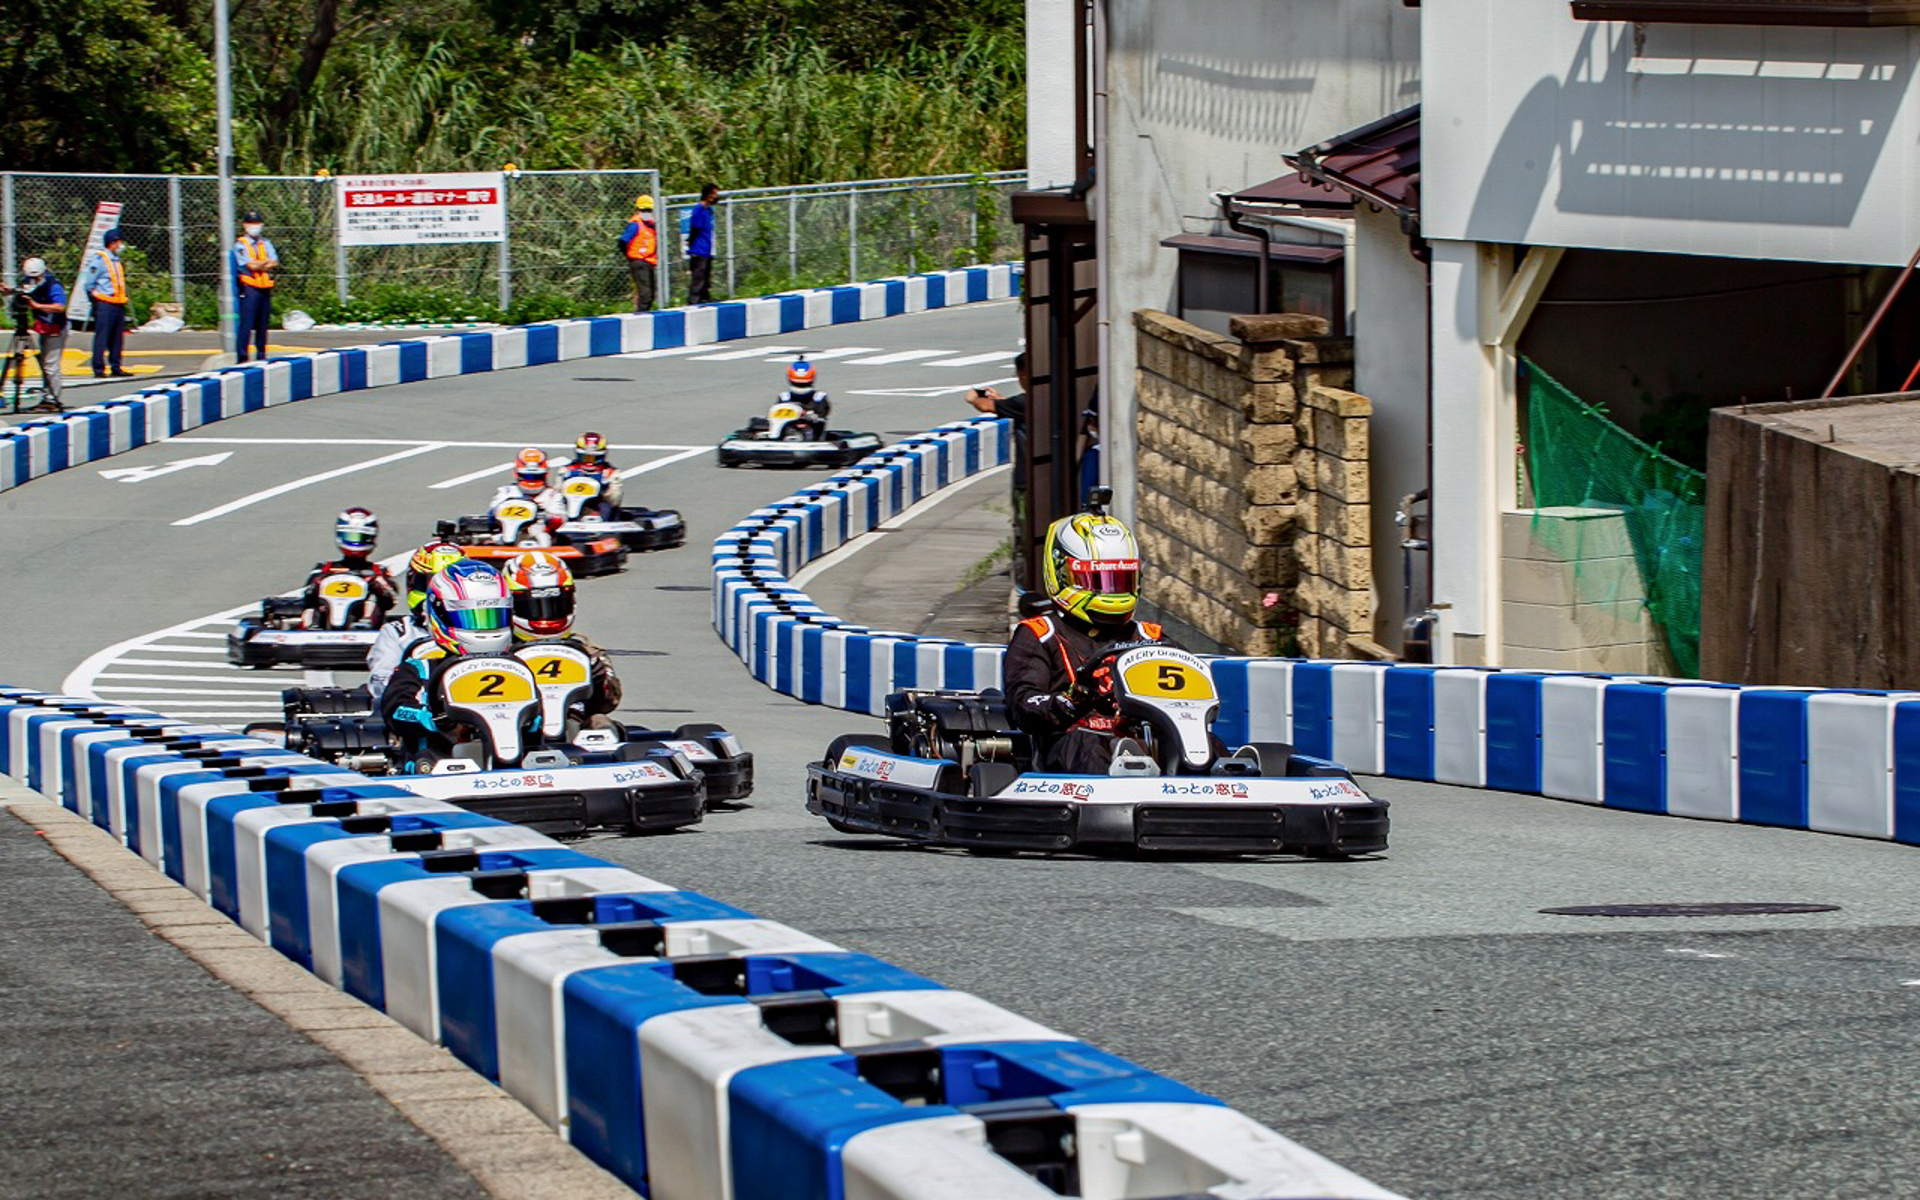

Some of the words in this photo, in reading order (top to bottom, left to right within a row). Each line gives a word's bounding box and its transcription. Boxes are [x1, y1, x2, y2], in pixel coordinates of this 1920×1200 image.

[506, 506, 527, 517] 12
[1090, 560, 1117, 571] Future
[335, 582, 351, 594] 3
[536, 659, 563, 679] 4
[476, 674, 507, 698] 2
[1157, 665, 1186, 691] 5
